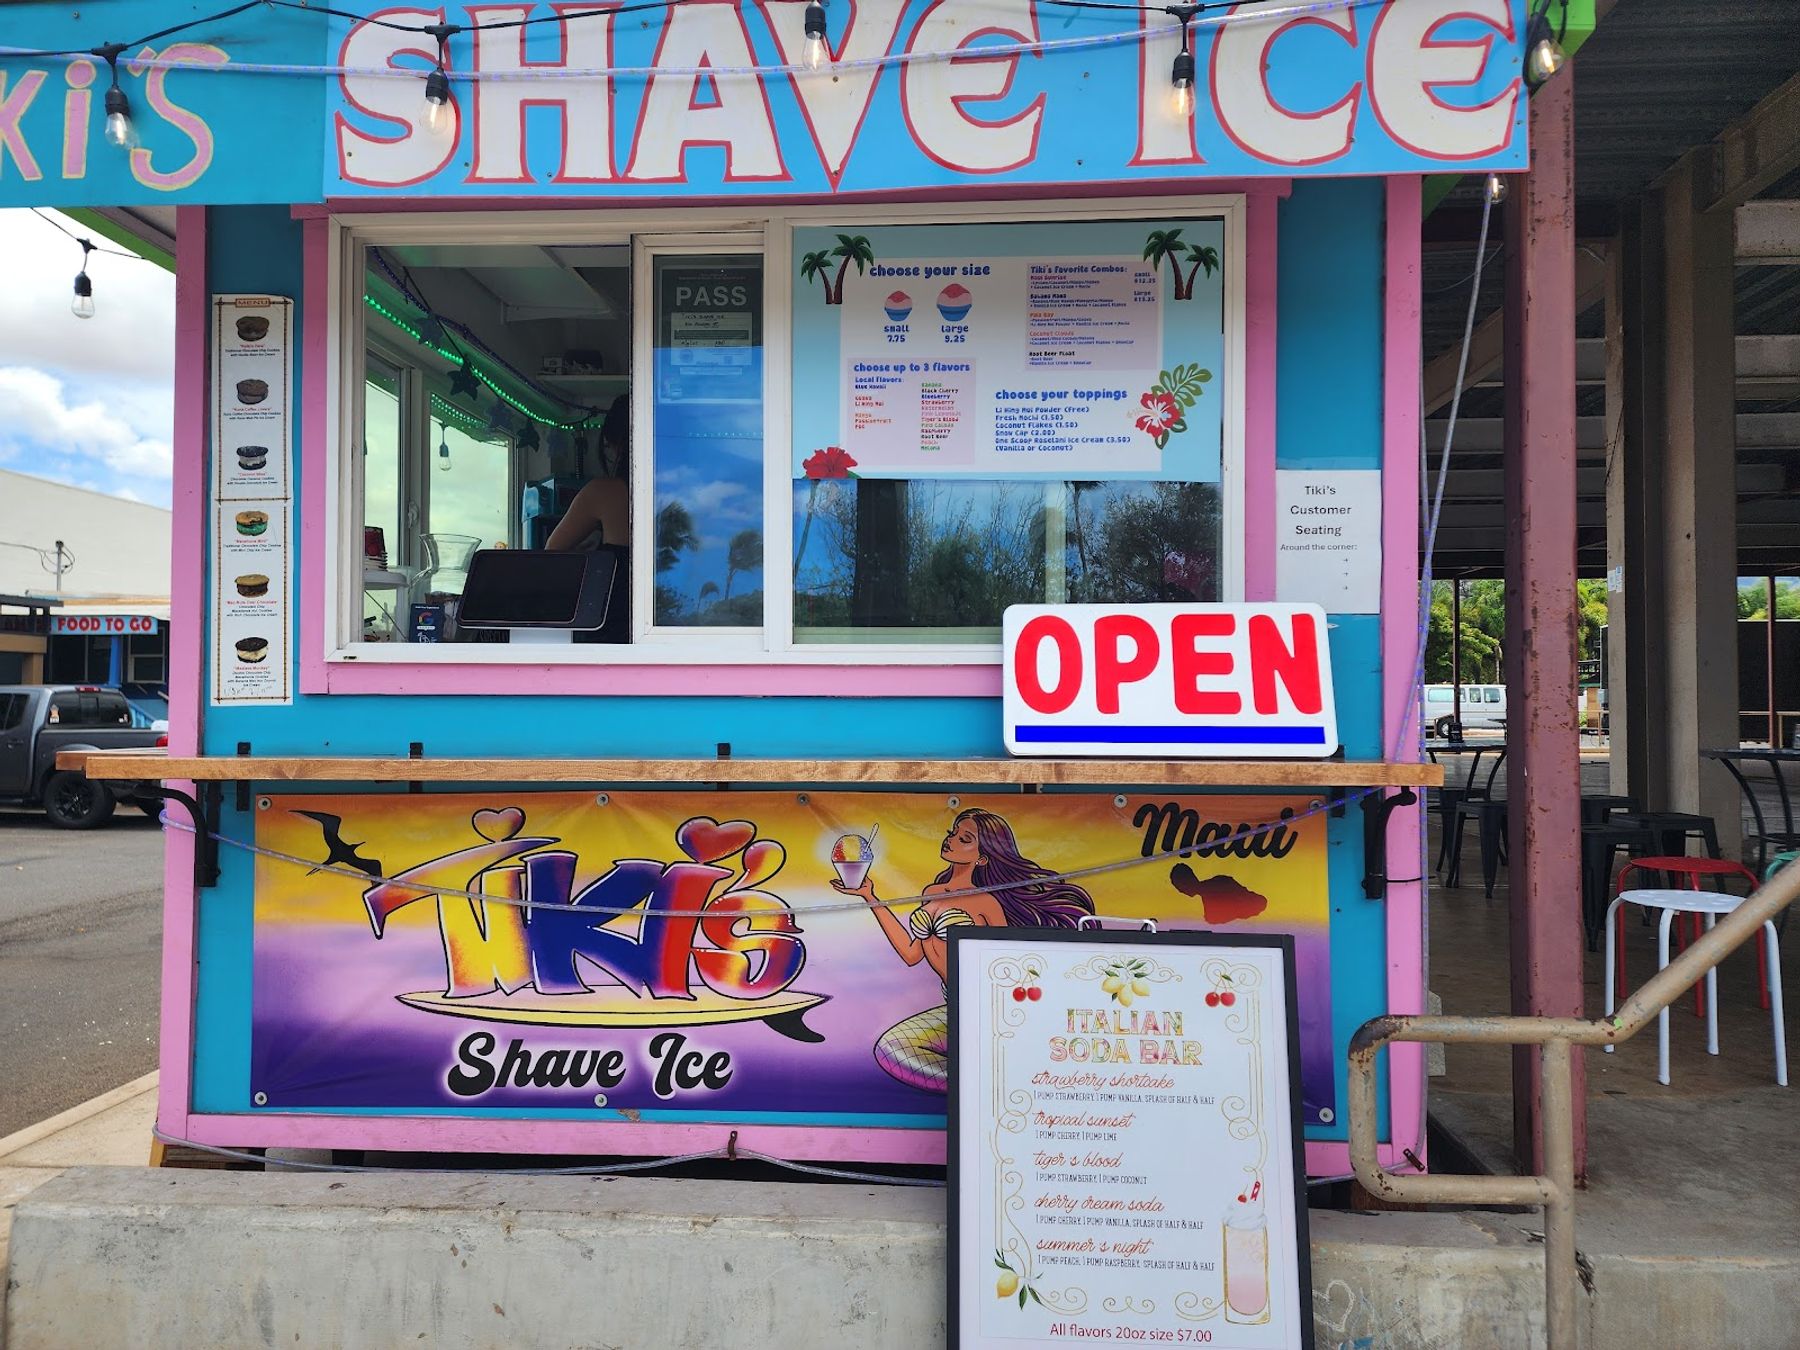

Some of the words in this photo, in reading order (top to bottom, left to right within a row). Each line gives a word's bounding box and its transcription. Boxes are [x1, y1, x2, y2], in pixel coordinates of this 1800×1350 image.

[333, 0, 1047, 194] SHAVE
[1127, 0, 1521, 167] ICE
[870, 264, 921, 278] choose
[925, 266, 958, 280] your
[962, 264, 990, 277] size
[1030, 265, 1052, 273] Tiki's
[675, 286, 748, 306] PASS
[883, 324, 910, 334] small
[942, 325, 969, 335] large
[888, 335, 906, 343] 7.75
[944, 335, 966, 343] 9.25
[854, 362, 891, 373] choose
[894, 364, 906, 374] up
[910, 362, 921, 373] to
[923, 363, 930, 372] 3
[932, 362, 971, 373] flavors
[995, 389, 1038, 400] choose
[1041, 391, 1070, 402] your
[1073, 389, 1128, 402] toppings
[1305, 485, 1337, 496] Tiki's
[1290, 505, 1352, 515] Customer
[1295, 525, 1342, 537] Seating
[57, 615, 101, 632] FOOD
[106, 617, 125, 632] TO
[129, 616, 153, 632] GO
[1013, 612, 1323, 716] OPEN
[1132, 802, 1298, 859] Maui
[1066, 1008, 1185, 1037] ITALIAN
[1048, 1036, 1133, 1064] SODA
[1139, 1039, 1204, 1067] BAR
[446, 1030, 627, 1097] Shave
[648, 1032, 735, 1097] Ice
[1031, 1071, 1107, 1091] strawberry
[1108, 1072, 1176, 1089] shortcake
[1037, 1091, 1055, 1101] PUMP
[1099, 1093, 1117, 1103] PUMP
[1145, 1094, 1168, 1104] SPLASH
[1168, 1095, 1176, 1104] OF
[1176, 1095, 1192, 1104] HALF
[1193, 1094, 1199, 1104] &
[1200, 1096, 1216, 1105] HALF
[1032, 1110, 1087, 1129] tropical
[1086, 1112, 1137, 1129] sunset
[1040, 1131, 1056, 1140] PUMP
[1086, 1132, 1103, 1141] PUMP
[1104, 1132, 1117, 1141] LIME
[1083, 1152, 1124, 1168] blood
[1039, 1172, 1056, 1182] PUMP
[1102, 1174, 1119, 1184] PUMP
[1121, 1175, 1147, 1185] COCONUT
[1034, 1192, 1079, 1214] cherry
[1081, 1195, 1125, 1211] cream
[1126, 1196, 1166, 1212] soda
[1040, 1214, 1056, 1224] PUMP
[1086, 1216, 1104, 1226] PUMP
[1132, 1218, 1155, 1228] SPLASH
[1156, 1219, 1163, 1228] OF
[1164, 1219, 1180, 1229] HALF
[1181, 1219, 1187, 1229] &
[1188, 1220, 1204, 1230] HALF
[1111, 1238, 1155, 1258] night
[1041, 1256, 1059, 1265] PUMP
[1086, 1258, 1103, 1268] PUMP
[1142, 1259, 1166, 1270] SPLASH
[1167, 1260, 1175, 1270] OF
[1176, 1260, 1192, 1270] HALF
[1193, 1260, 1199, 1270] &
[1199, 1261, 1216, 1271] HALF
[1050, 1324, 1067, 1338] All
[1069, 1323, 1112, 1339] flavors
[1115, 1326, 1146, 1340] 20oz
[1149, 1328, 1174, 1341] size
[1176, 1329, 1213, 1343] $7.00
